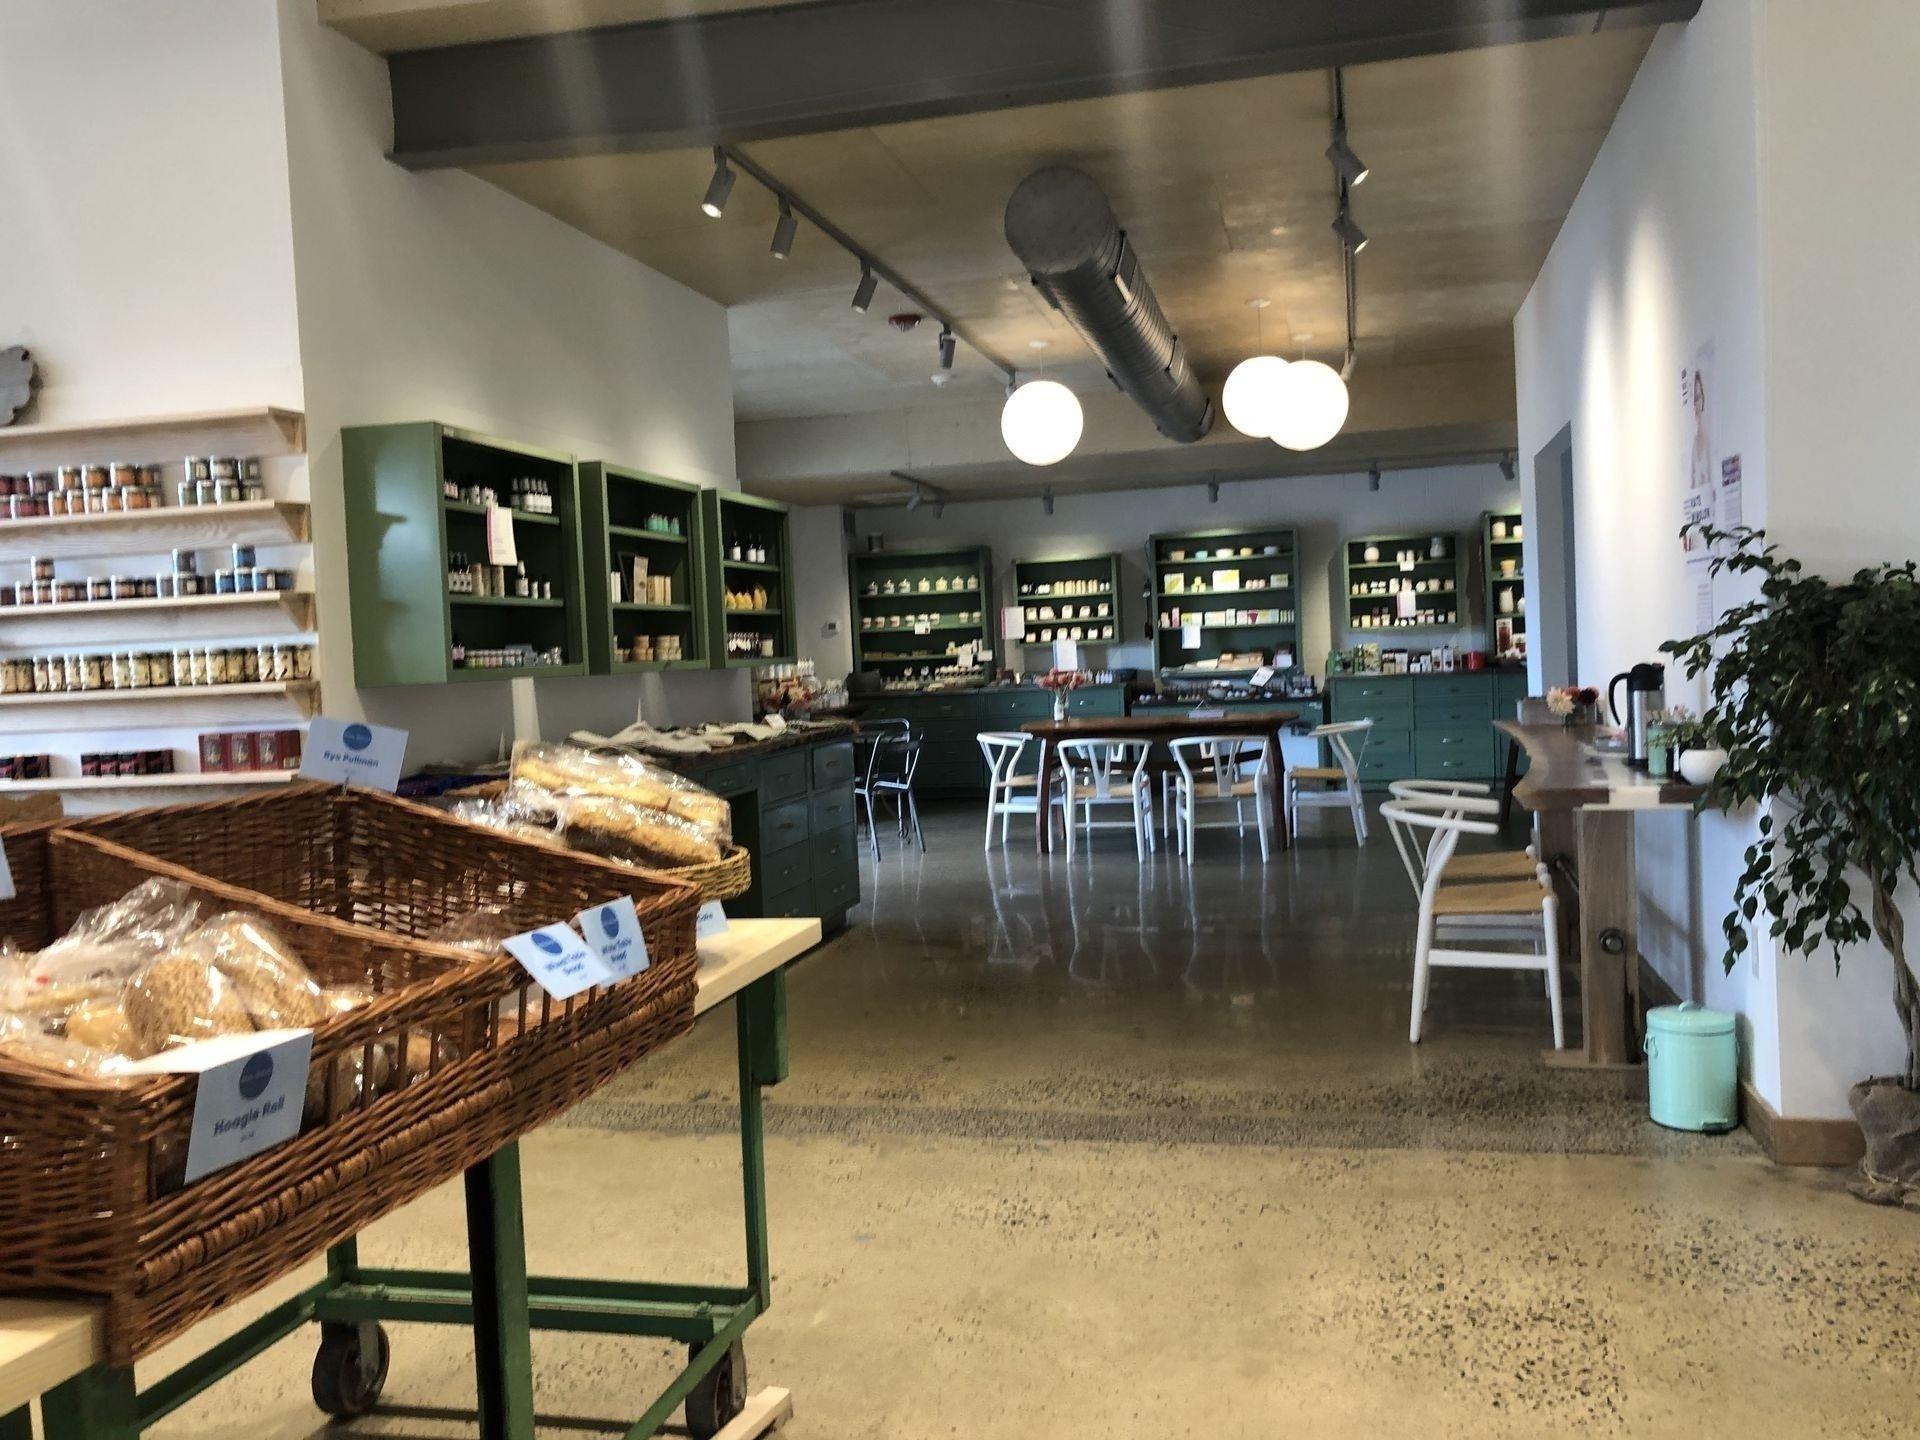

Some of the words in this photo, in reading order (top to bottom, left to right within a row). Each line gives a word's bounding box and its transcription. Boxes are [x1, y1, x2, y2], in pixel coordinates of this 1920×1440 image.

[342, 752, 379, 768] Pullman
[213, 1109, 260, 1138] Hoagie
[262, 1094, 285, 1118] Roll
